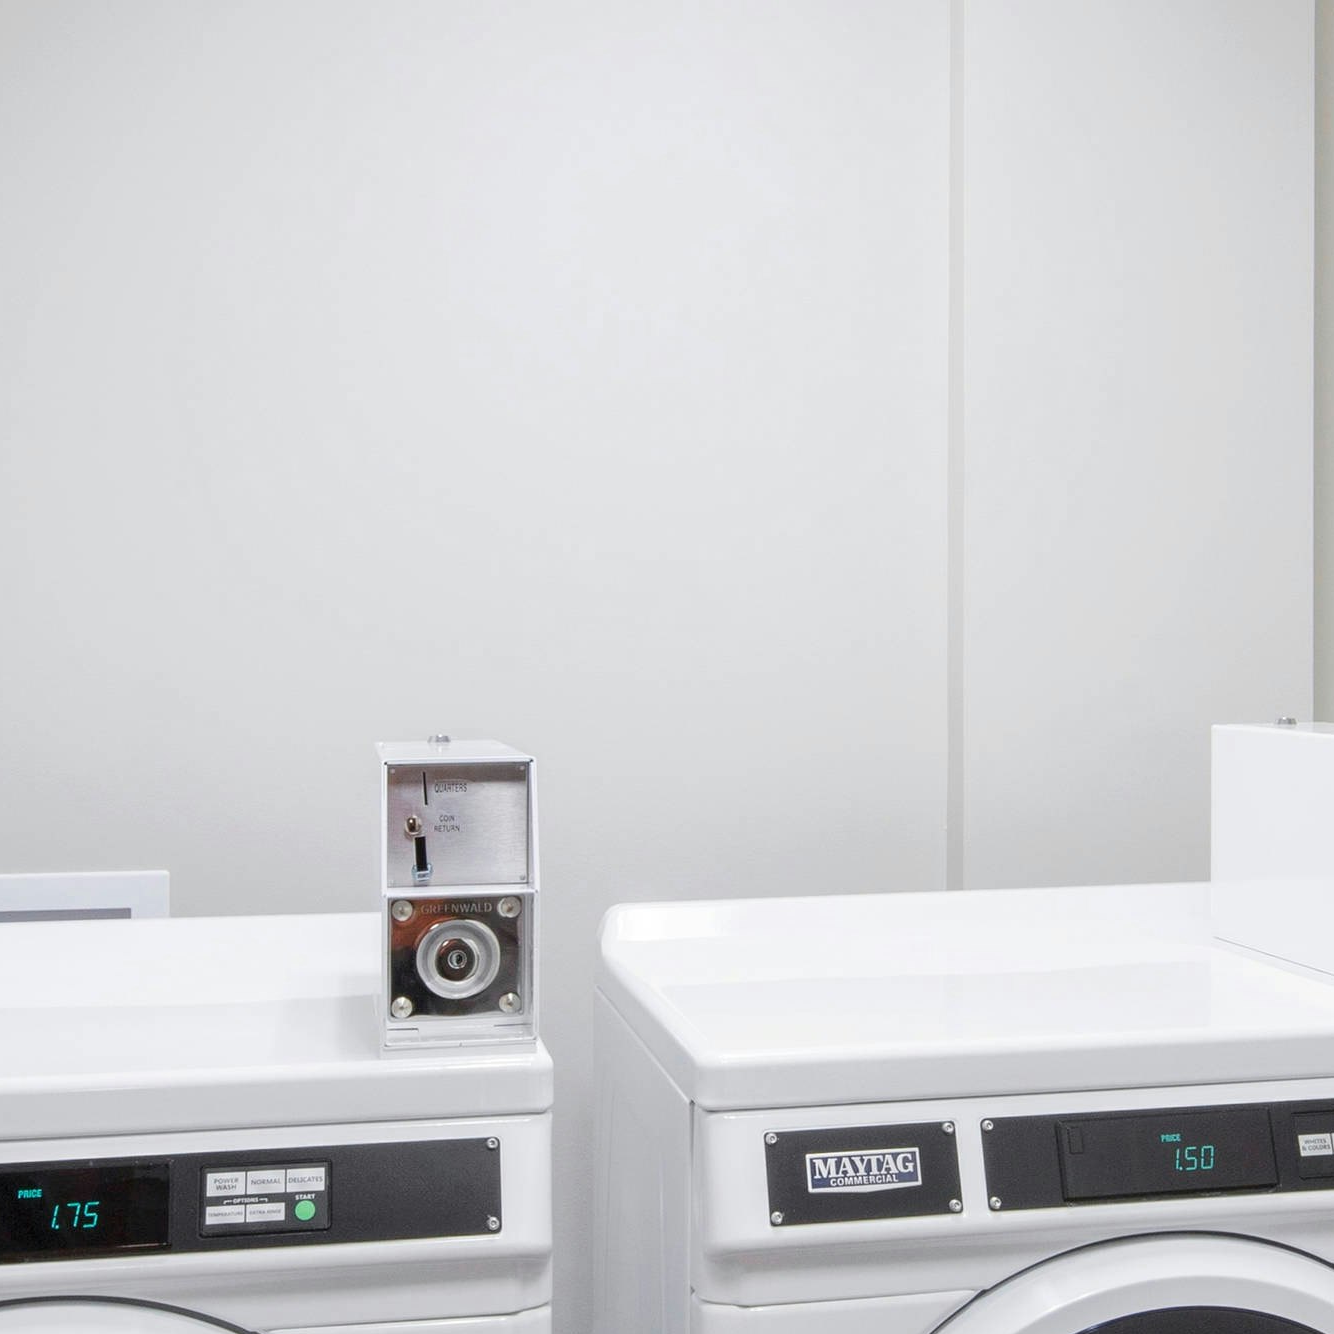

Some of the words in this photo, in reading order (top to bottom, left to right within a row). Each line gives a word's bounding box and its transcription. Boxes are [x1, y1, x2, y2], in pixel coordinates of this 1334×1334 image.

[434, 783, 467, 793] QUARTERS
[439, 815, 455, 823] COIN
[421, 902, 492, 913] GREENWALD
[1176, 1145, 1214, 1171] 1.50
[812, 1153, 915, 1179] MAYTAG
[288, 1176, 323, 1184] DELICATES
[830, 1174, 899, 1187] COMMERCIAL
[18, 1189, 43, 1199] PRICE
[51, 1201, 100, 1230] 1.75
